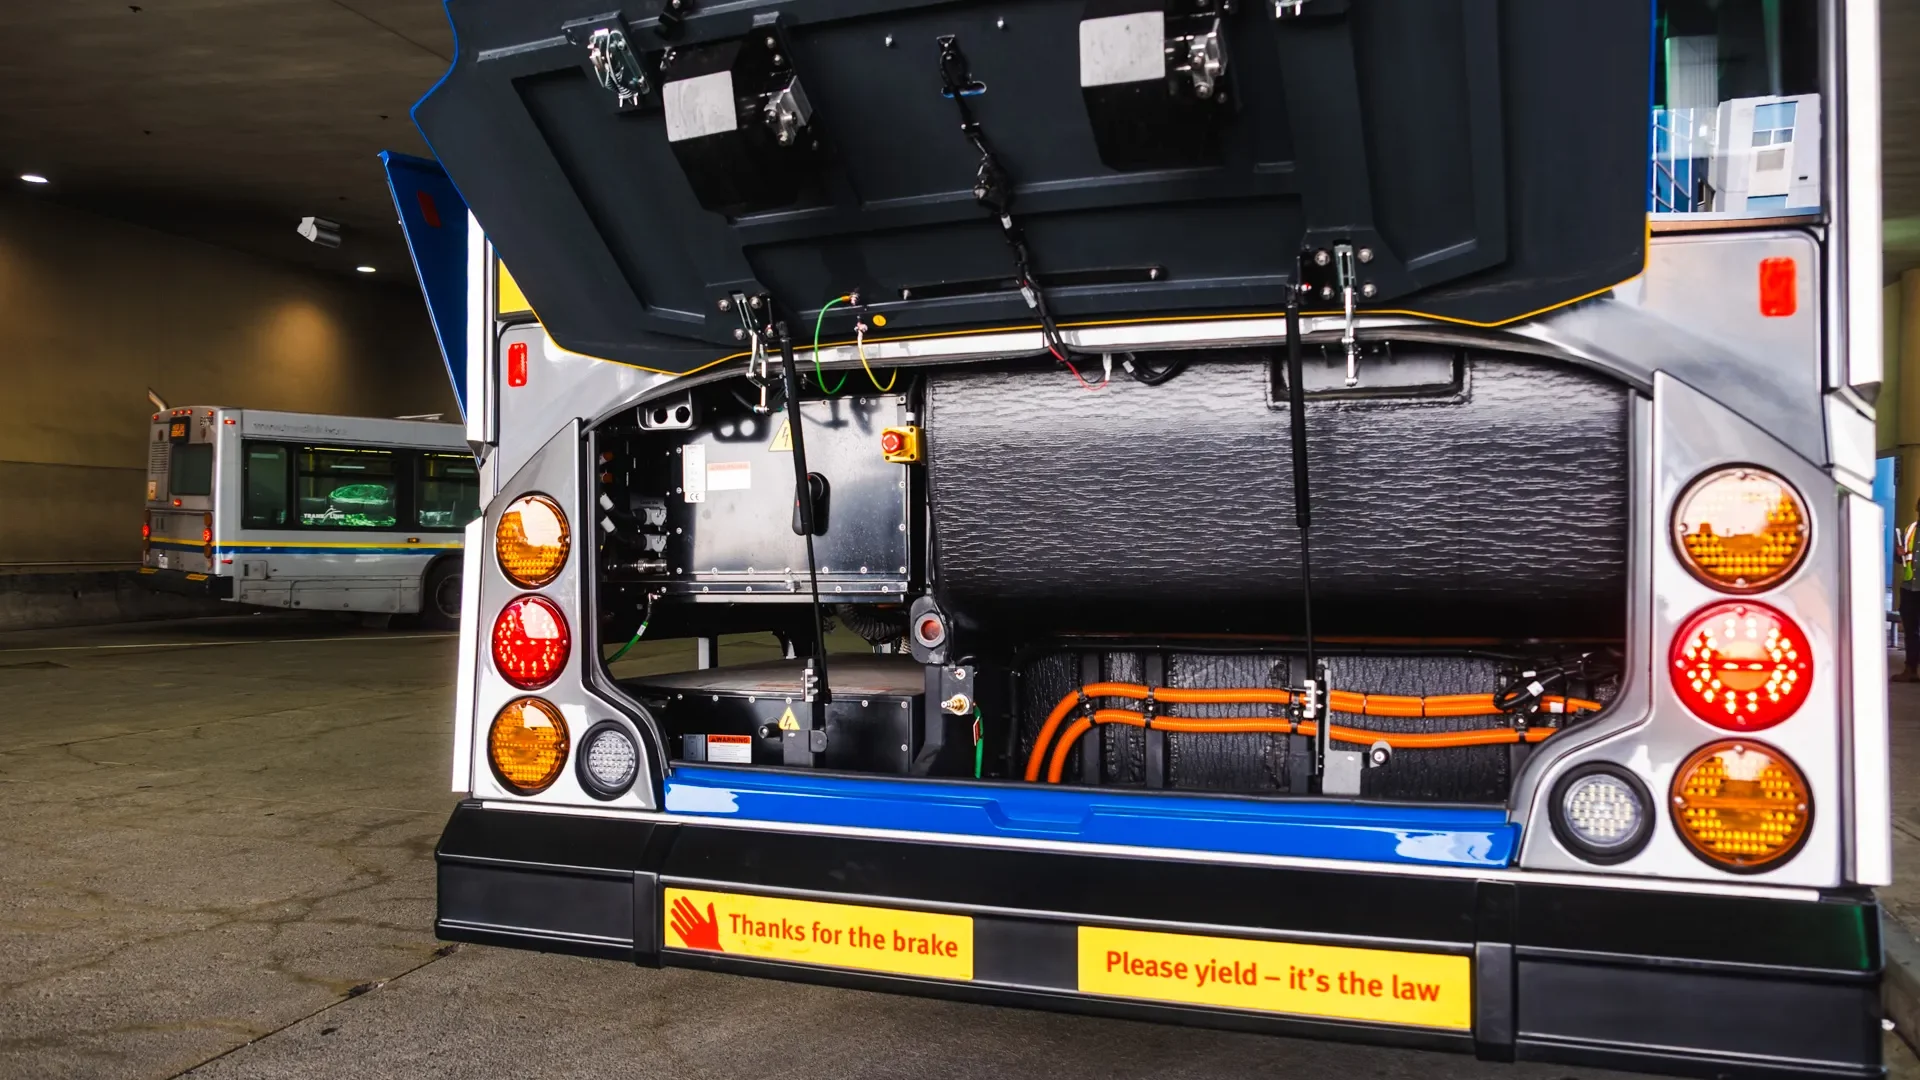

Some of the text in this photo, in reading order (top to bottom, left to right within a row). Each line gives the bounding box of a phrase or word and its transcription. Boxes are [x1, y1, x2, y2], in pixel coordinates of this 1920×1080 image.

[728, 913, 958, 958] Thanks for the brake
[1106, 950, 1188, 980] Please
[1194, 958, 1257, 988] yield
[1338, 970, 1383, 998] the
[1392, 974, 1440, 1002] law
